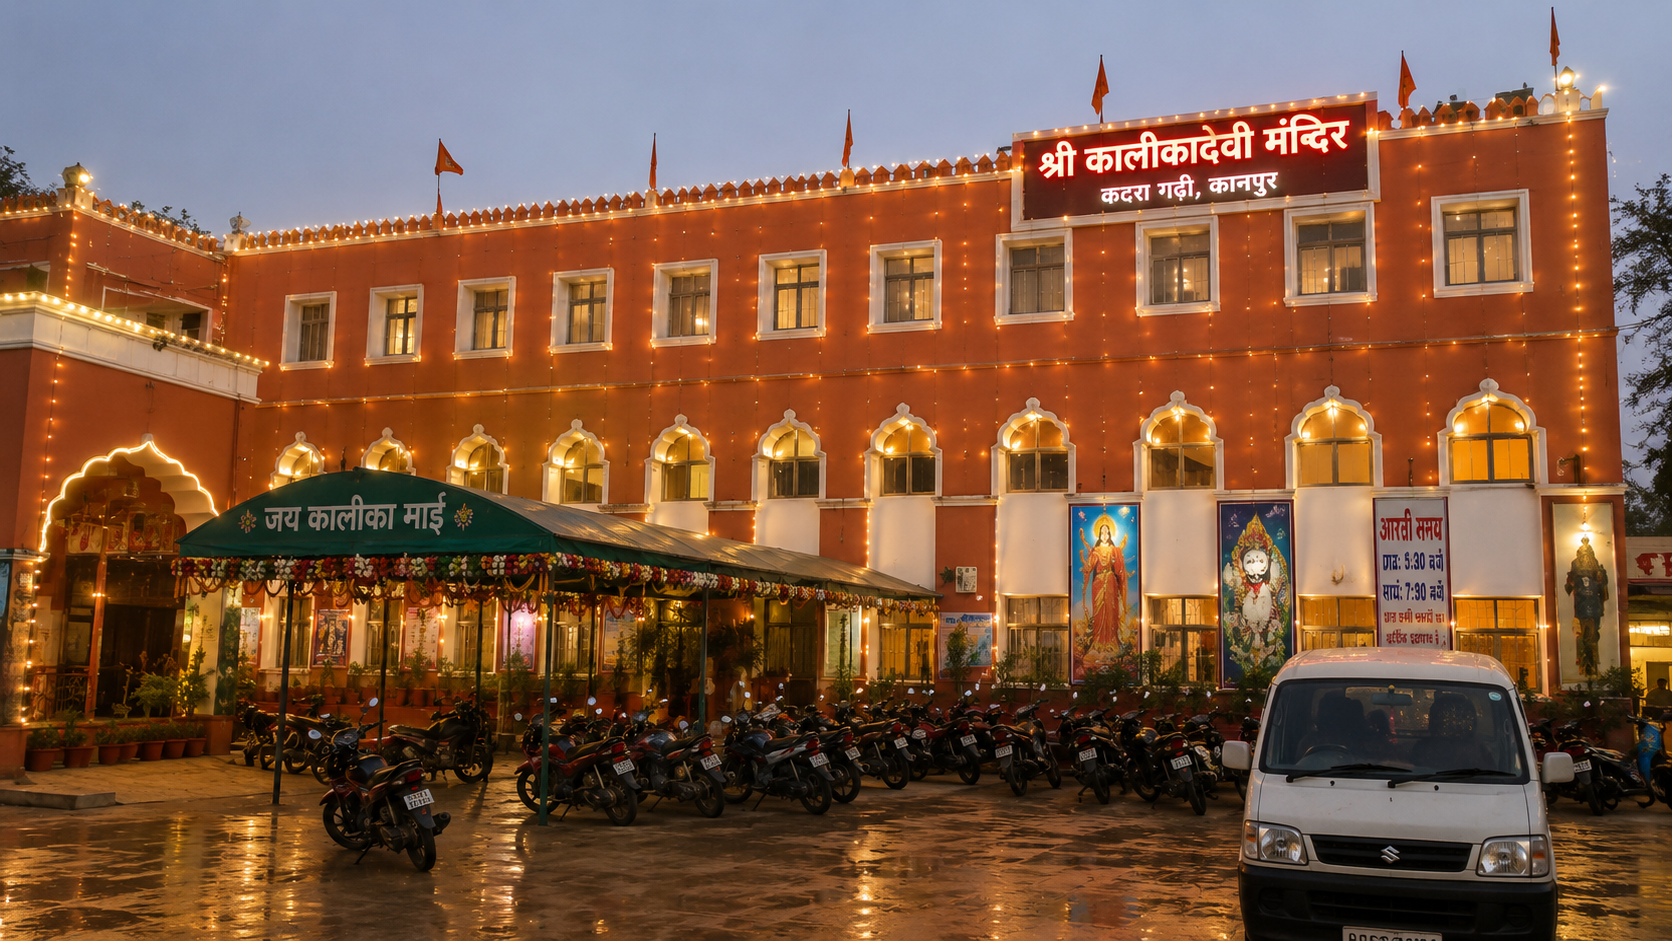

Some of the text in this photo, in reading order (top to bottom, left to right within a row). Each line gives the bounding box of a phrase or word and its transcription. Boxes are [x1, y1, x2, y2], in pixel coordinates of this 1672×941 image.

[1038, 140, 1077, 179] श्री
[1084, 120, 1254, 174] कालीकादेवी
[1100, 184, 1151, 205] कदरा
[1208, 171, 1279, 197] कानपुर
[264, 491, 447, 536] जय कालीका माई
[1404, 551, 1426, 571] 5:30
[1405, 582, 1427, 601] 7:30
